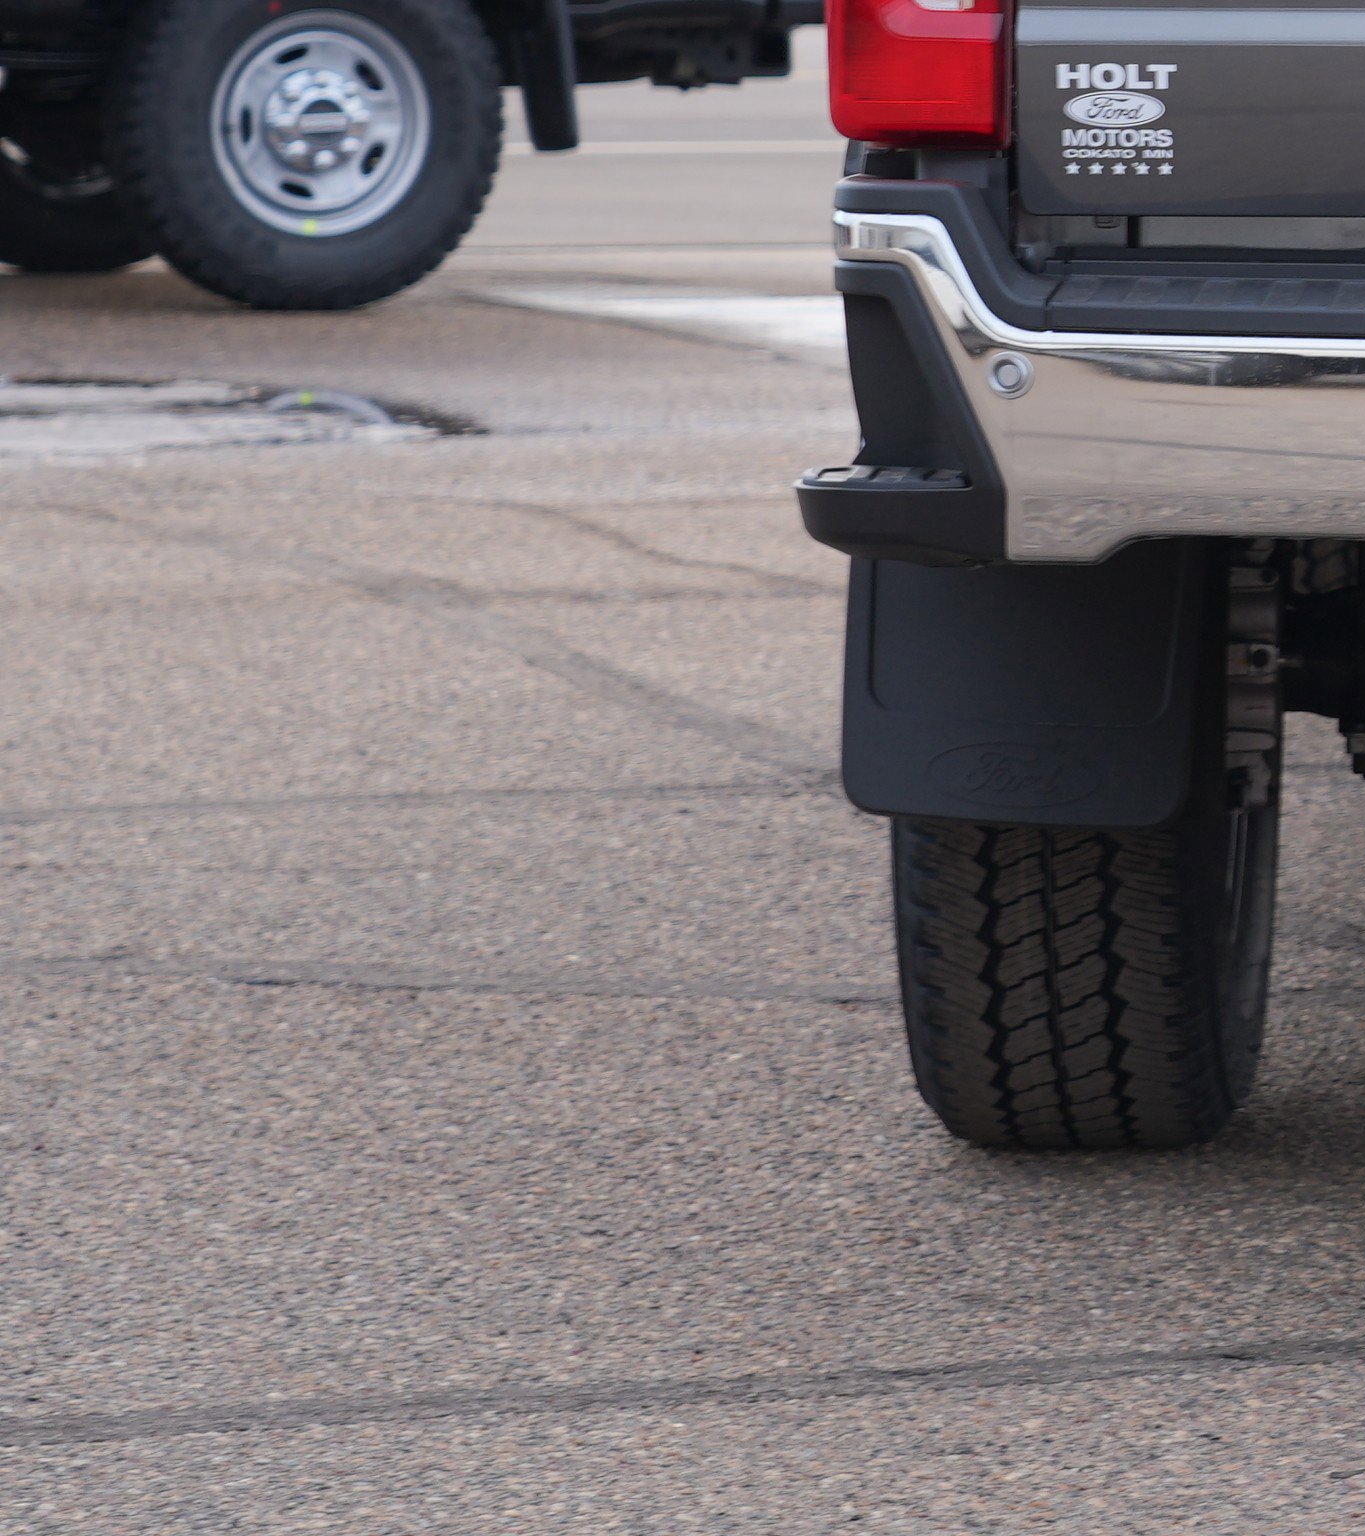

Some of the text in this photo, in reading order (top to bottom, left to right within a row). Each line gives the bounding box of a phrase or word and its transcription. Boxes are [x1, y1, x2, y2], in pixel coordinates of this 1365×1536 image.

[1055, 63, 1177, 89] HOLT
[1086, 96, 1144, 119] Ford
[1061, 128, 1174, 147] MOTORS
[1062, 149, 1174, 159] COKATO MN
